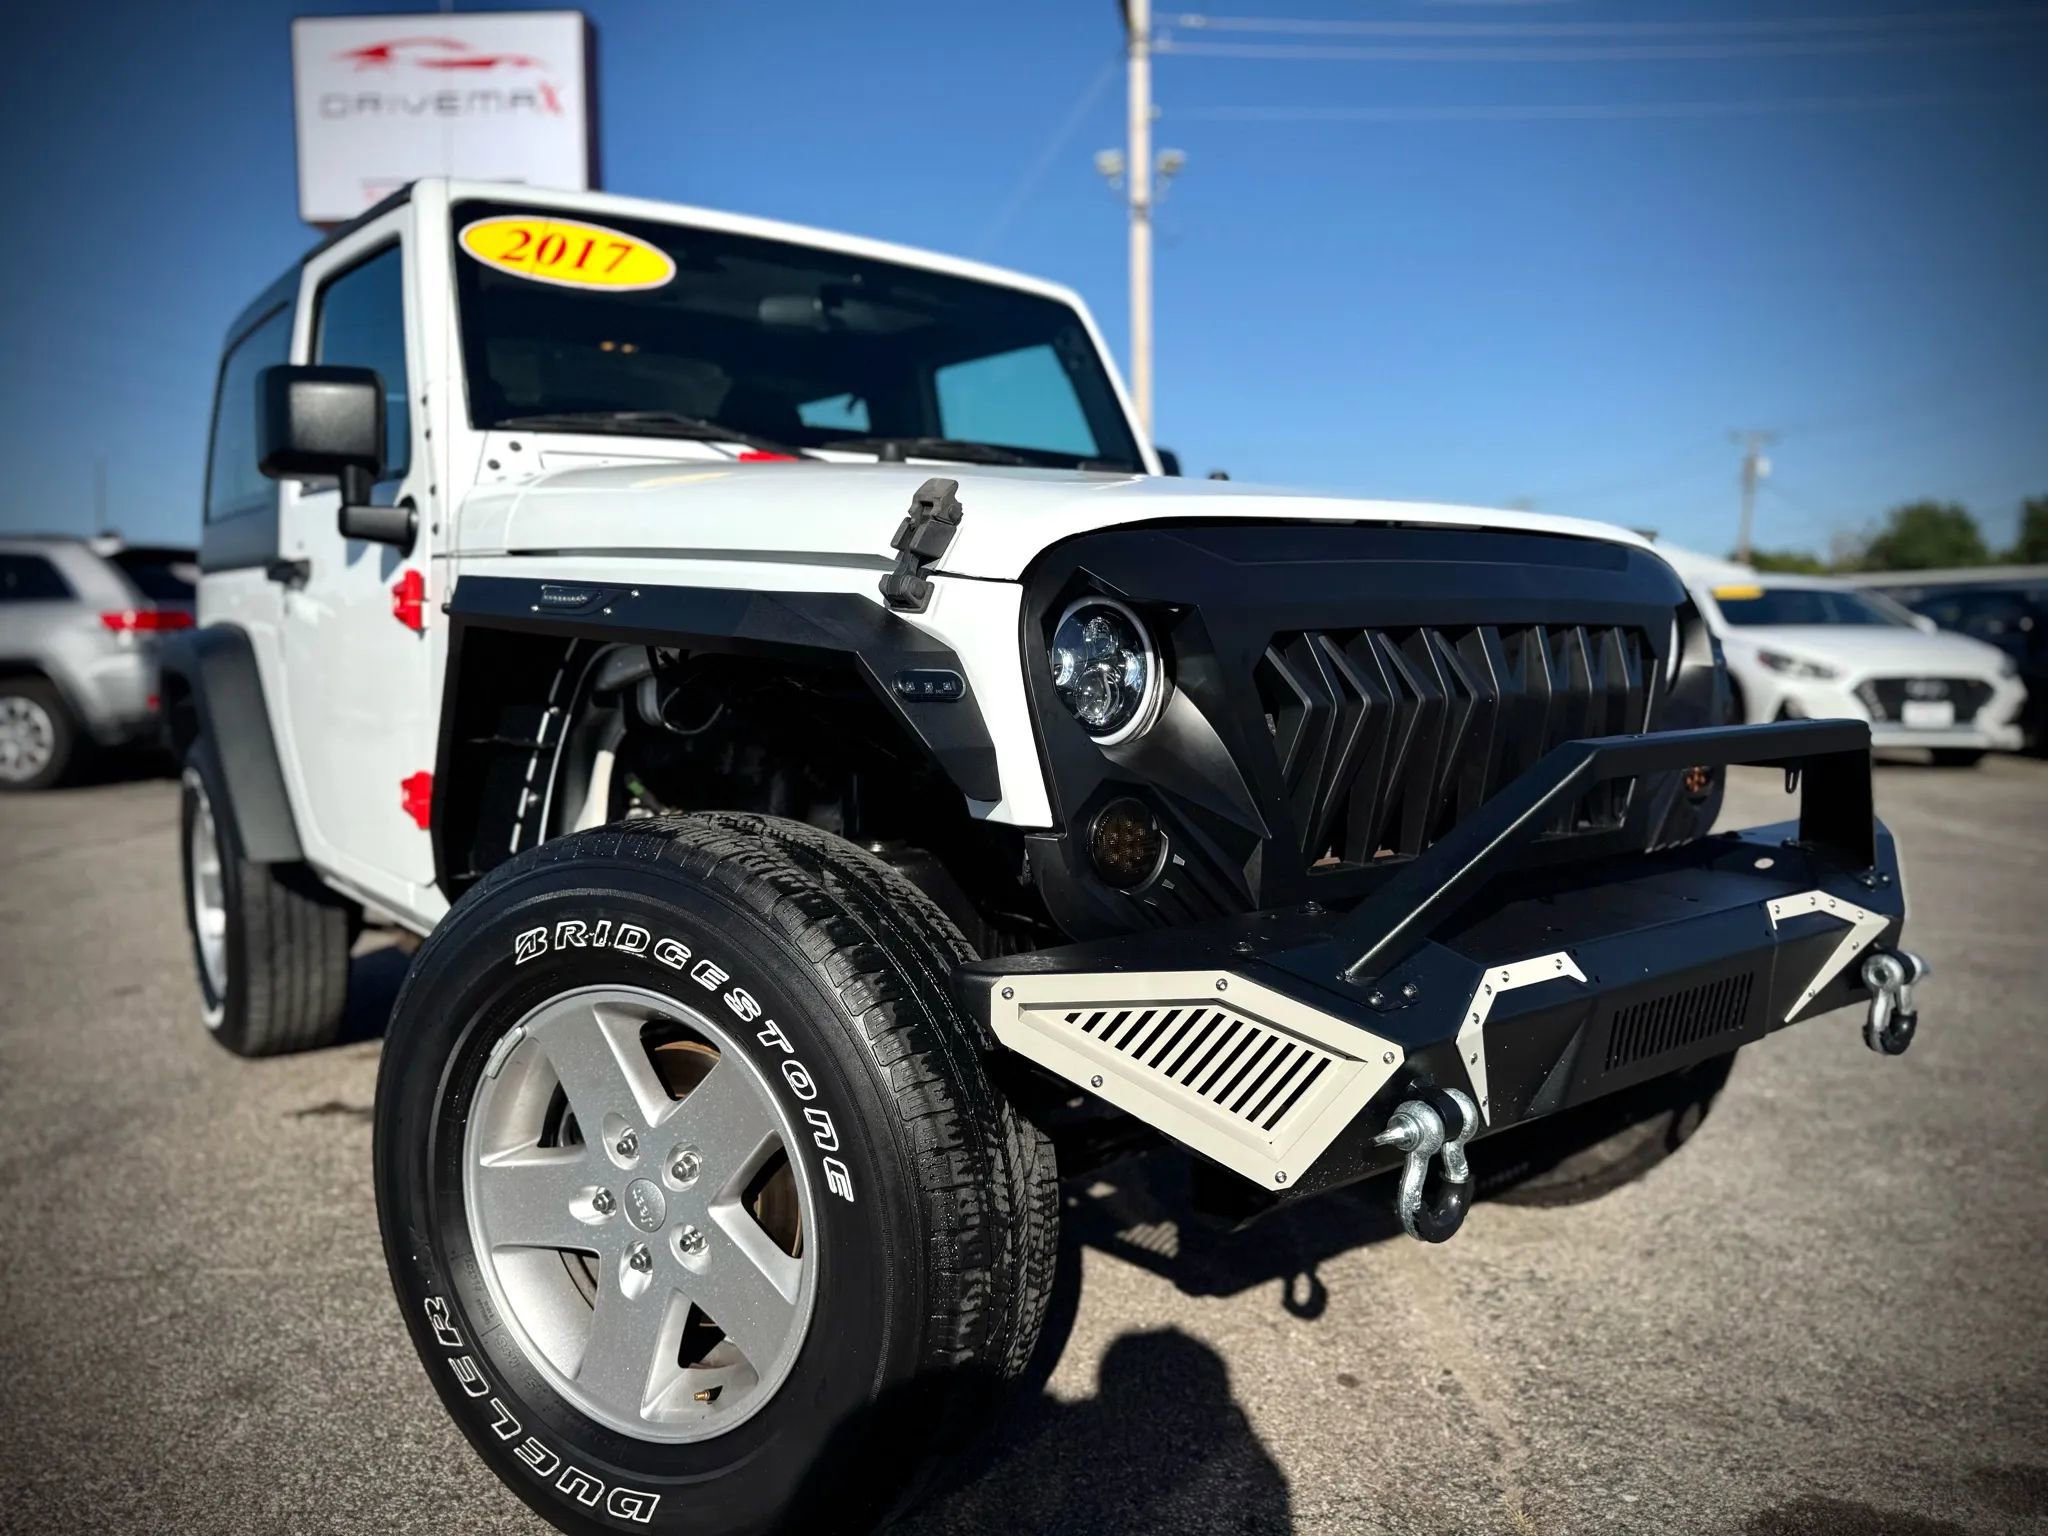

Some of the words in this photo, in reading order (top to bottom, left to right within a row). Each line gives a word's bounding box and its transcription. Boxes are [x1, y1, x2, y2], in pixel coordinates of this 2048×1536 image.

[319, 81, 563, 119] DRIVEMAX
[499, 229, 635, 275] 2017
[514, 919, 855, 1203] BRIDGESTONE
[424, 1296, 661, 1524] DUELER
